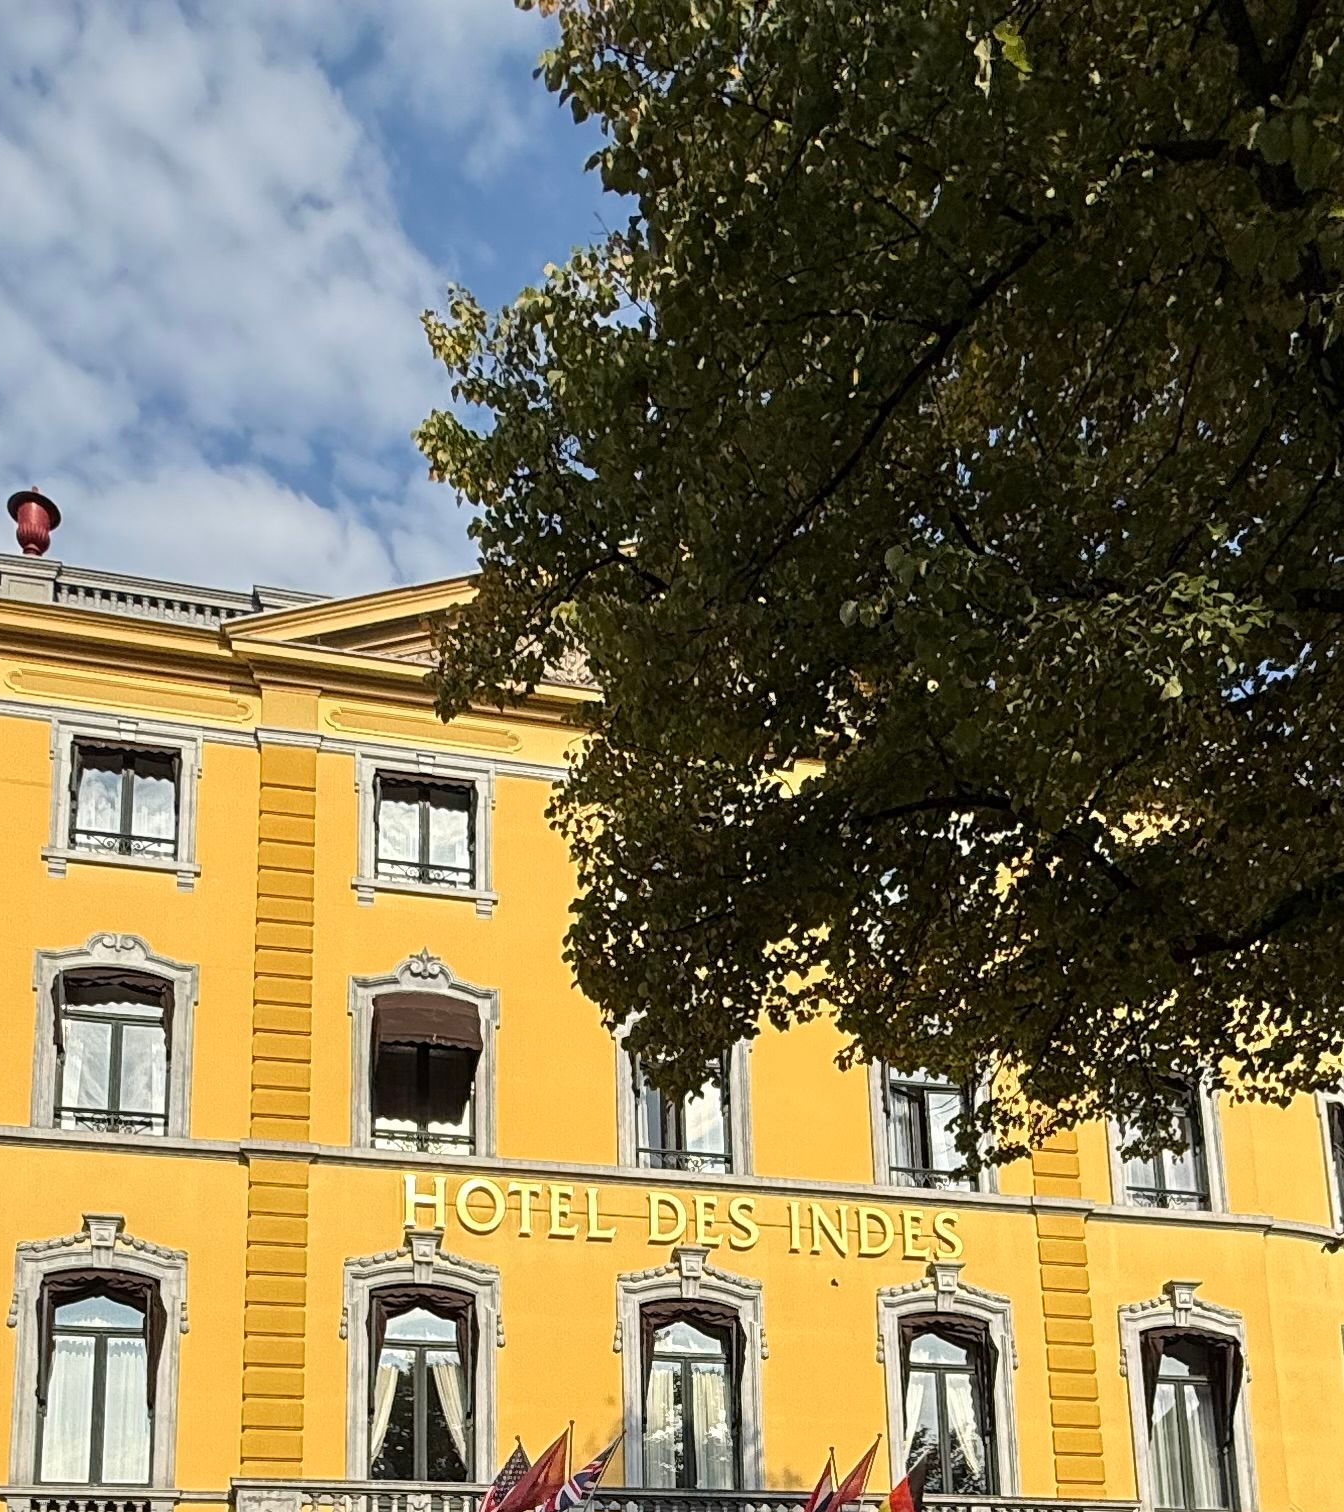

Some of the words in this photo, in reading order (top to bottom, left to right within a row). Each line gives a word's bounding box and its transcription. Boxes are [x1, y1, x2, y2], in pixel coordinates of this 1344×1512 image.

[403, 1173, 617, 1242] HOTEL
[647, 1191, 760, 1249] DES
[788, 1200, 964, 1260] INDES
